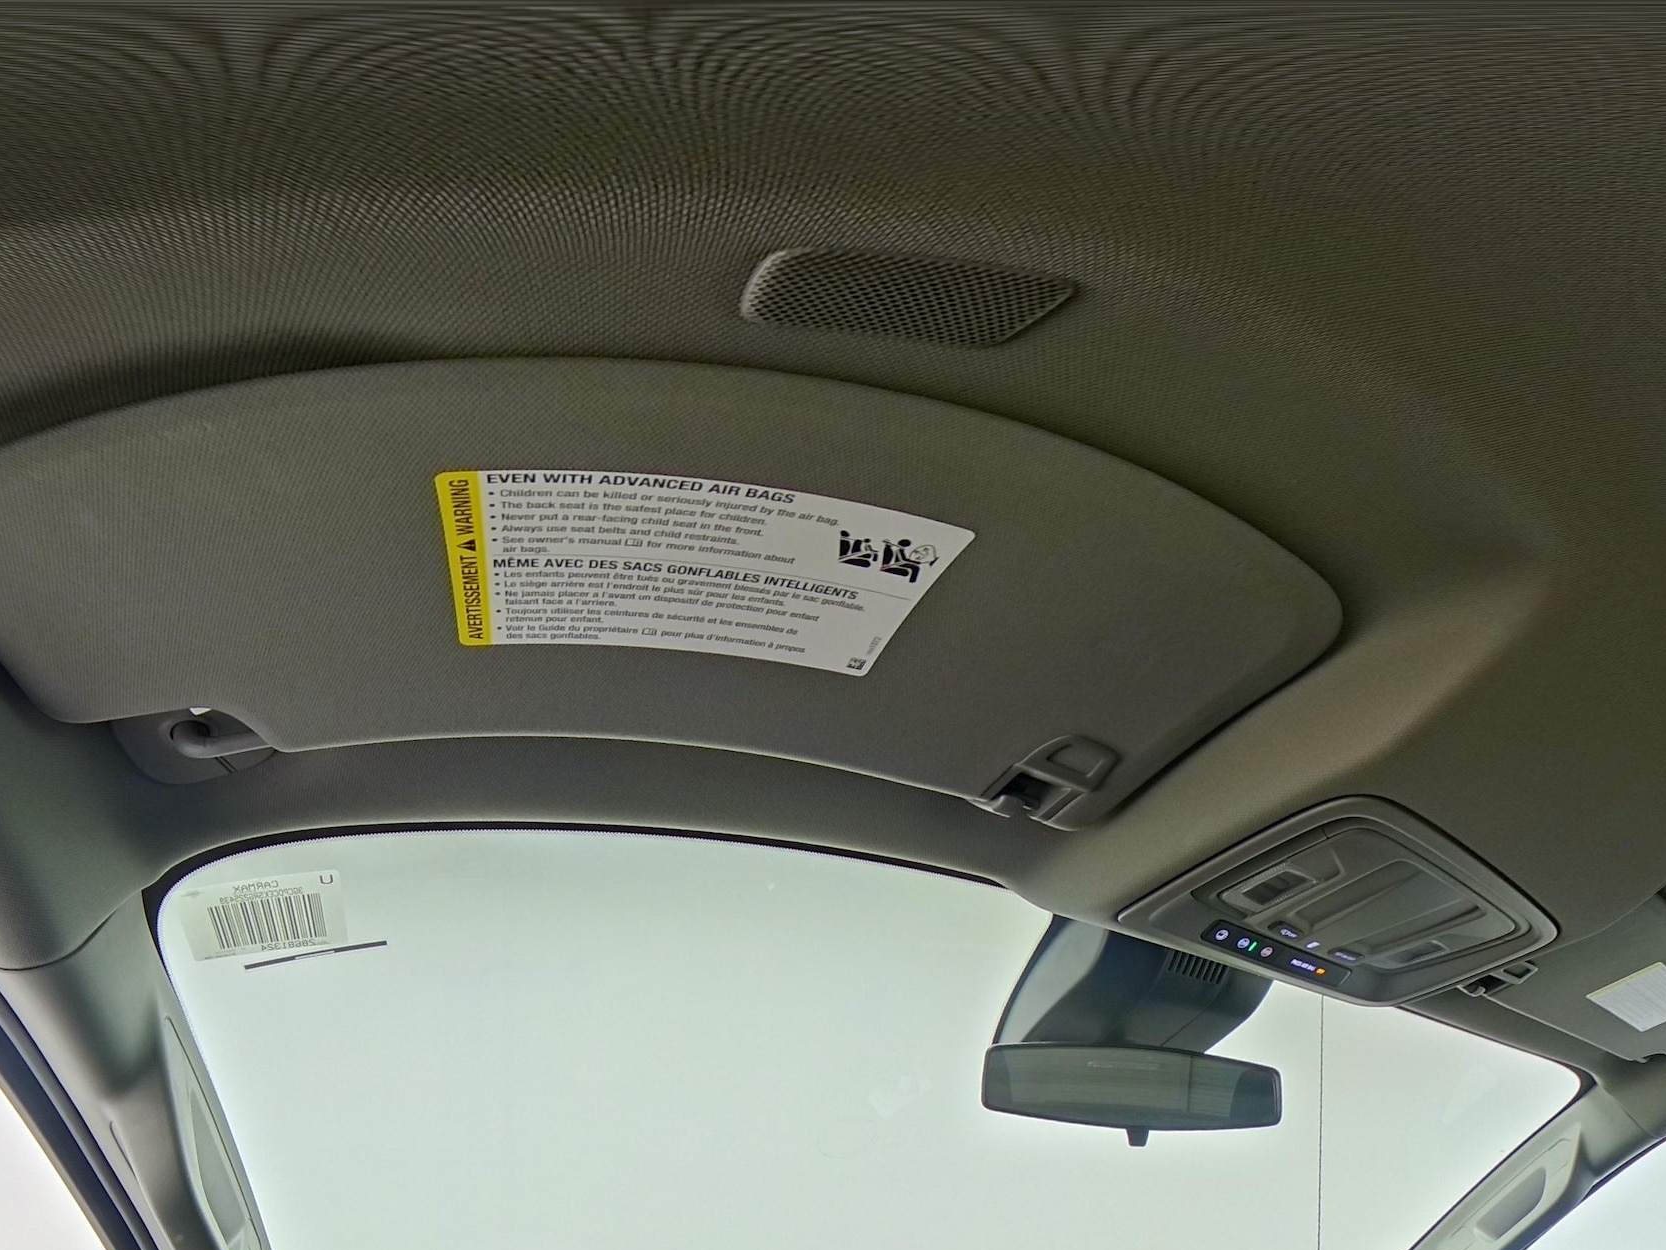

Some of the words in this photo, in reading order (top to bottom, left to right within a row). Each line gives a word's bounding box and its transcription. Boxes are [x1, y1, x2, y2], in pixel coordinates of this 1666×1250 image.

[487, 474, 535, 483] EVEN
[543, 474, 592, 484] WITH
[598, 475, 703, 492] ADVANCED
[707, 483, 740, 496] AIR
[744, 487, 795, 503] BAGS
[449, 479, 475, 536] WARNING
[500, 489, 552, 497] Children
[583, 490, 598, 498] be
[603, 490, 637, 499] killed
[656, 495, 712, 507] seriously
[715, 499, 756, 511] injured
[759, 504, 774, 515] by
[776, 507, 795, 517] the
[798, 511, 814, 520] air
[816, 514, 839, 526] bag.
[559, 501, 585, 509] seat
[603, 502, 622, 511] the
[625, 504, 661, 513] safest
[664, 507, 696, 516] place
[699, 509, 715, 518] for
[718, 512, 766, 525] children.
[501, 512, 535, 520] Never
[539, 513, 558, 522] put
[572, 514, 637, 526] rear-facing
[641, 517, 669, 526] child
[699, 521, 710, 530] in
[713, 523, 731, 532] the
[734, 525, 763, 536] front.
[501, 525, 542, 534] Always
[598, 526, 625, 534] belts
[654, 529, 681, 538] child
[684, 532, 739, 545] restraints.
[520, 545, 549, 554] bags.
[646, 540, 661, 548] for
[665, 542, 694, 551] more
[763, 554, 795, 564] about
[493, 557, 539, 568] MÊME
[543, 558, 583, 568] AVEC
[588, 559, 617, 569] DES
[621, 561, 662, 572] SACS
[666, 564, 760, 583] GONFLABLES
[763, 575, 859, 599] INTELLIGENTS
[460, 554, 483, 640] AVERTISSEMENT
[545, 616, 567, 624] pour
